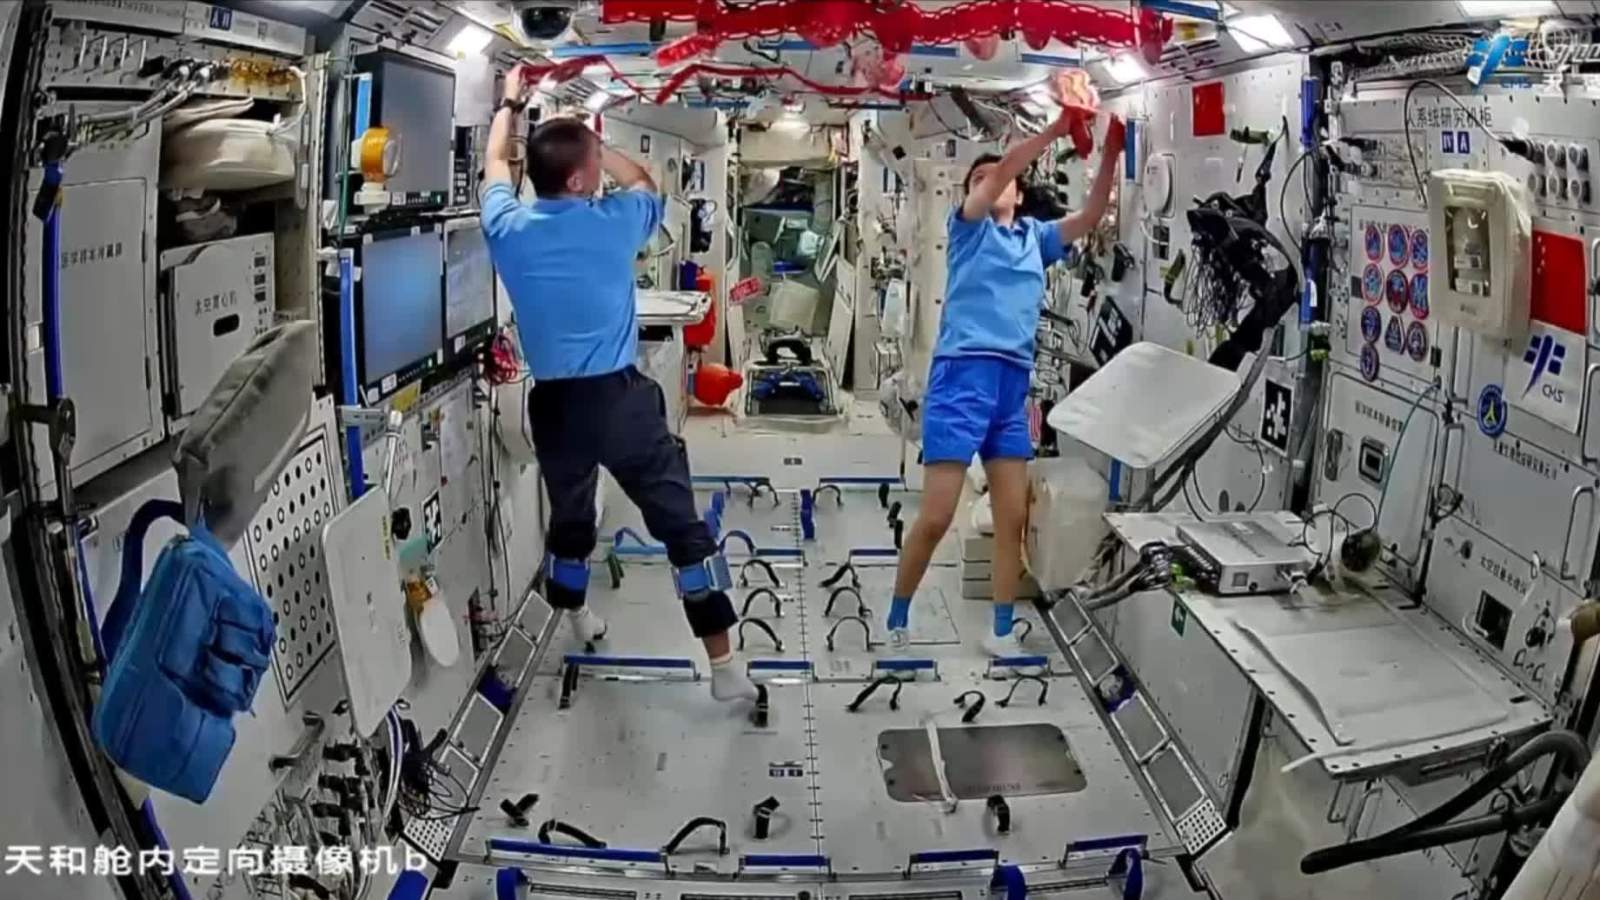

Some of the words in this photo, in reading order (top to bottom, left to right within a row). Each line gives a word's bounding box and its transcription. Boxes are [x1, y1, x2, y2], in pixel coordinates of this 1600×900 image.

[1407, 105, 1493, 128] 人系统研究机柜
